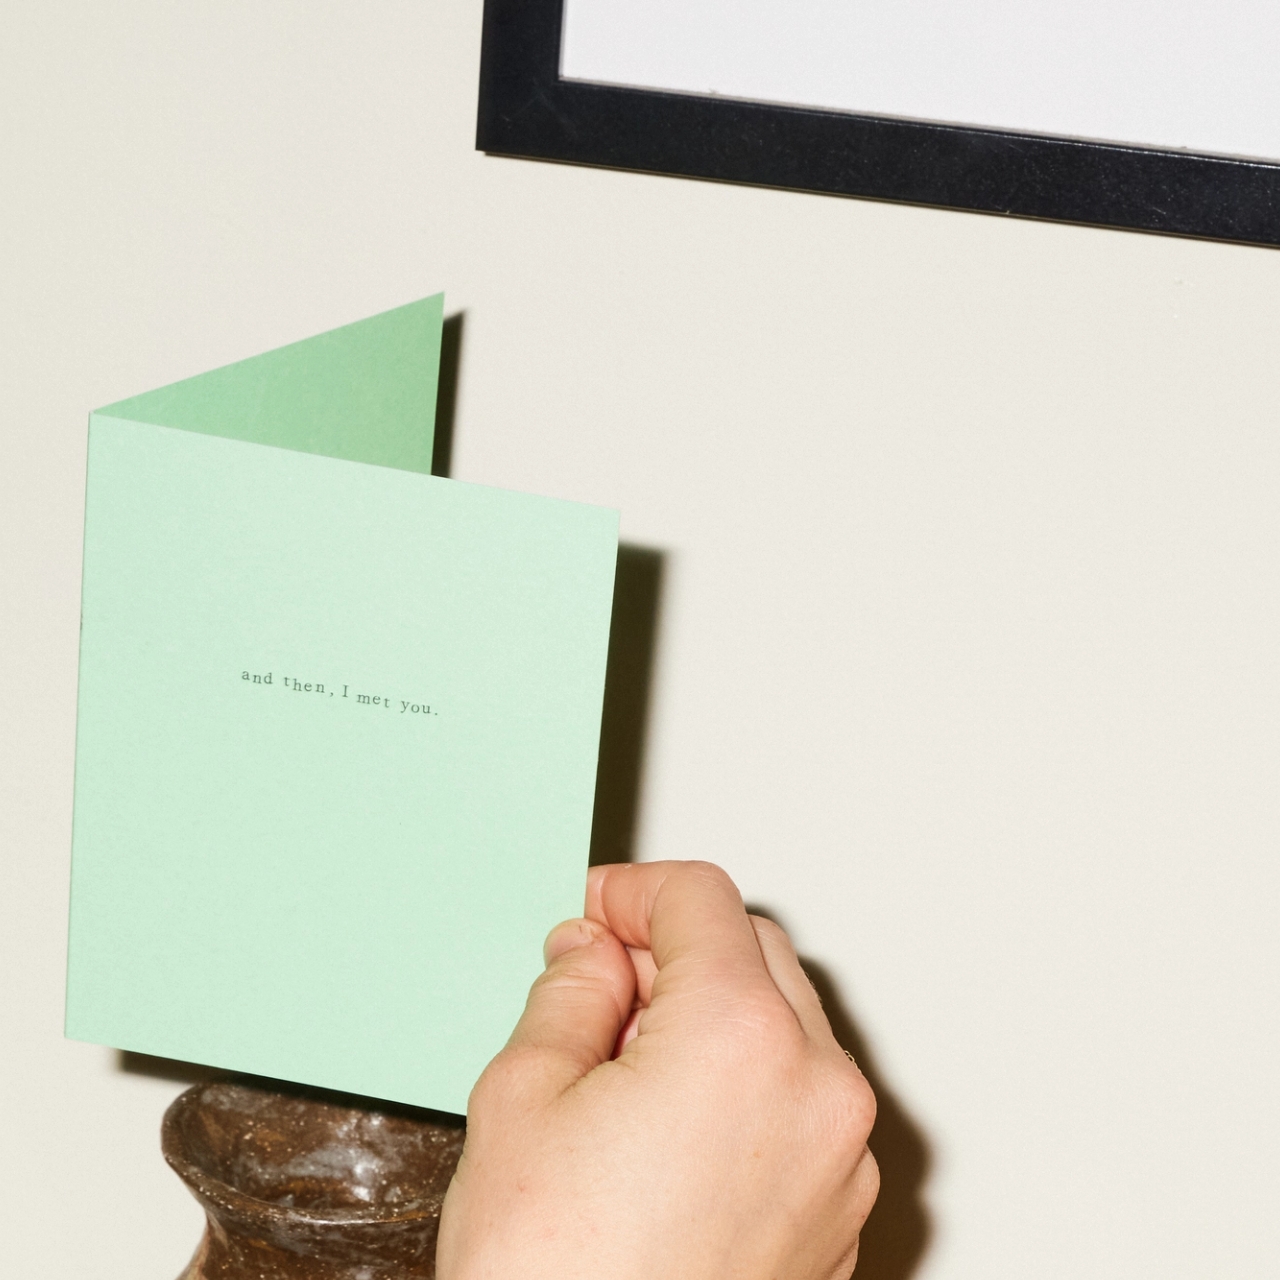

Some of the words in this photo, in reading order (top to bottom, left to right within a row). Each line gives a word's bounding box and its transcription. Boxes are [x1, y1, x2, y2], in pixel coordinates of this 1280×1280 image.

[241, 670, 273, 685] and
[284, 676, 334, 698] then,
[342, 684, 350, 698] I
[357, 693, 390, 709] met
[401, 699, 439, 716] you.
